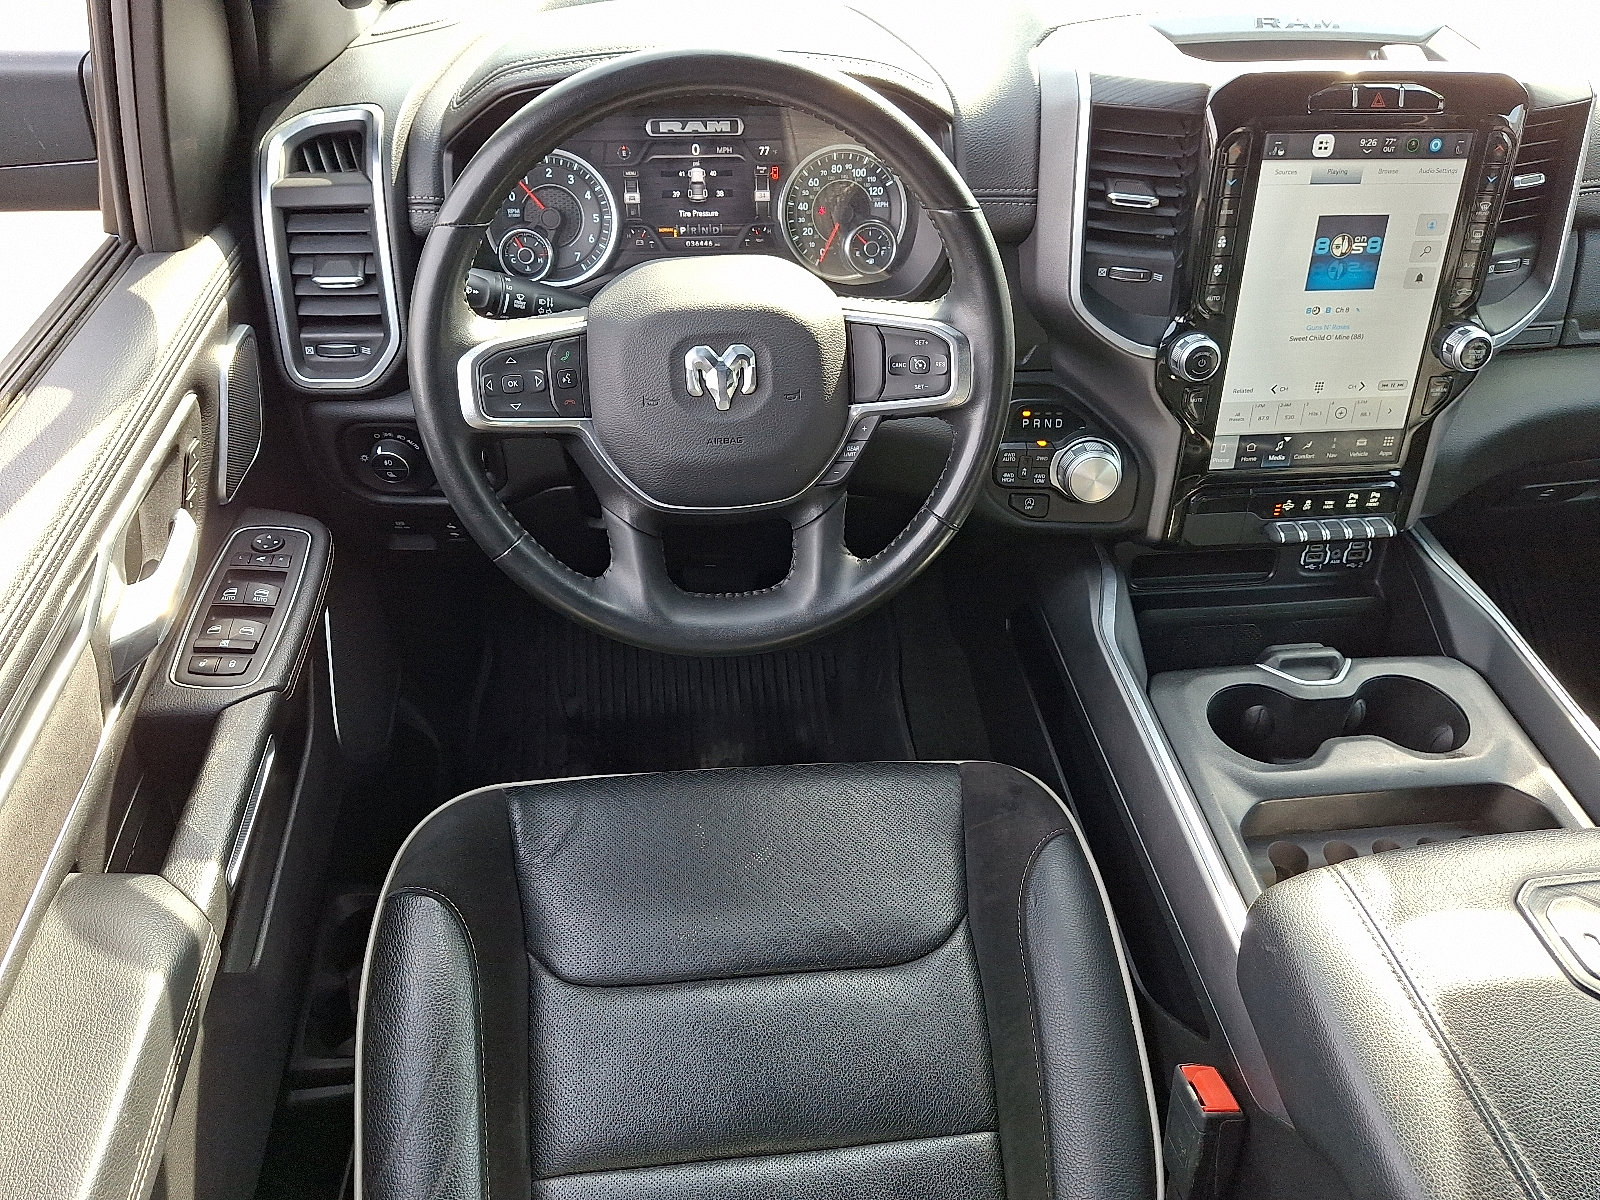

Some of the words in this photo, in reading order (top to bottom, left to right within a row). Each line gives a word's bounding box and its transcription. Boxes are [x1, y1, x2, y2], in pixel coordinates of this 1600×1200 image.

[659, 121, 731, 133] RAM
[1360, 138, 1378, 147] 9:26
[691, 143, 700, 156] 0
[758, 146, 770, 156] 77
[545, 168, 553, 178] 2
[831, 164, 843, 173] 80
[851, 168, 866, 178] 100
[1327, 168, 1348, 176] Playing
[567, 175, 575, 184] 3
[808, 178, 819, 187] 60
[584, 190, 591, 200] 4
[868, 186, 883, 196] 120
[508, 192, 516, 201] 0
[798, 202, 808, 211] 40
[679, 209, 691, 217] Tire
[592, 214, 600, 223] 5
[680, 226, 687, 235] P
[802, 227, 813, 236] 20
[588, 234, 595, 243] 6
[1366, 236, 1382, 254] 8
[574, 252, 581, 261] 7
[1022, 419, 1029, 428] P
[1033, 419, 1041, 428] R
[1044, 419, 1052, 428] N
[1055, 419, 1063, 428] D
[706, 436, 744, 445] AIRBAG
